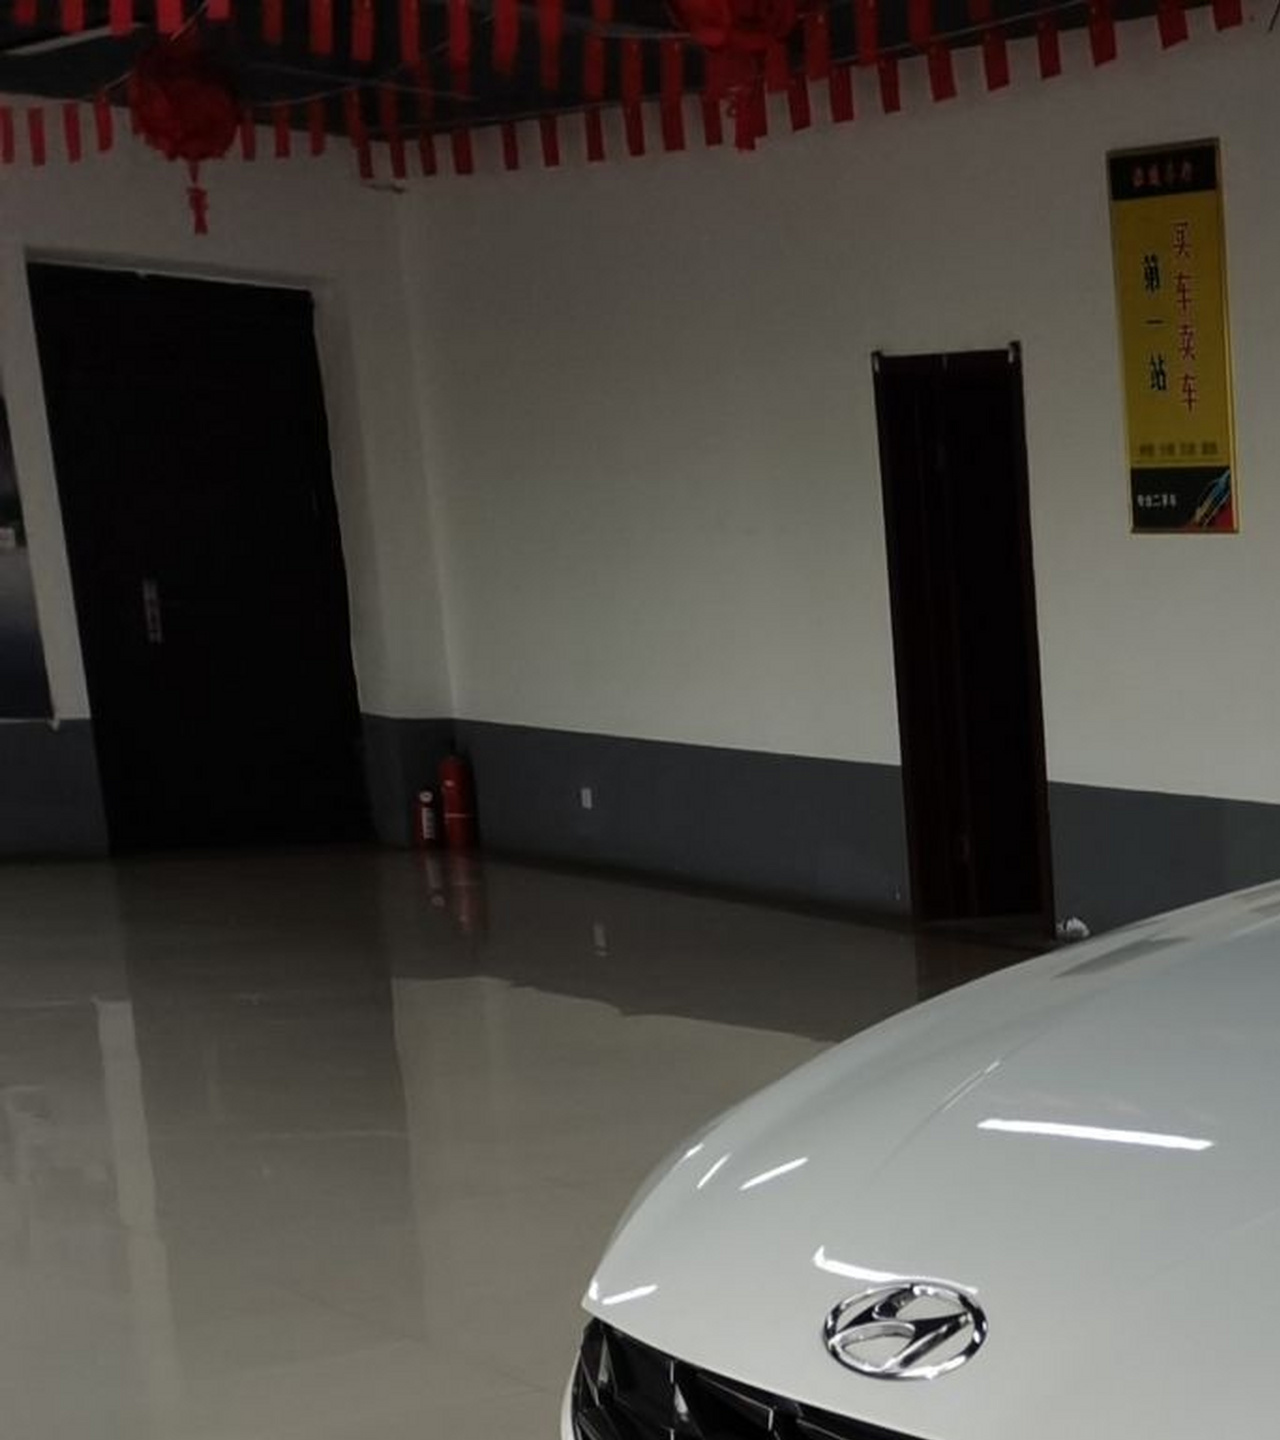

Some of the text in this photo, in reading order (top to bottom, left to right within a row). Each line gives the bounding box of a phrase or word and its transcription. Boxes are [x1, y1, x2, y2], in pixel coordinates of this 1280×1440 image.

[1143, 254, 1167, 391] 第一站
[1173, 221, 1198, 412] 买车卖车
